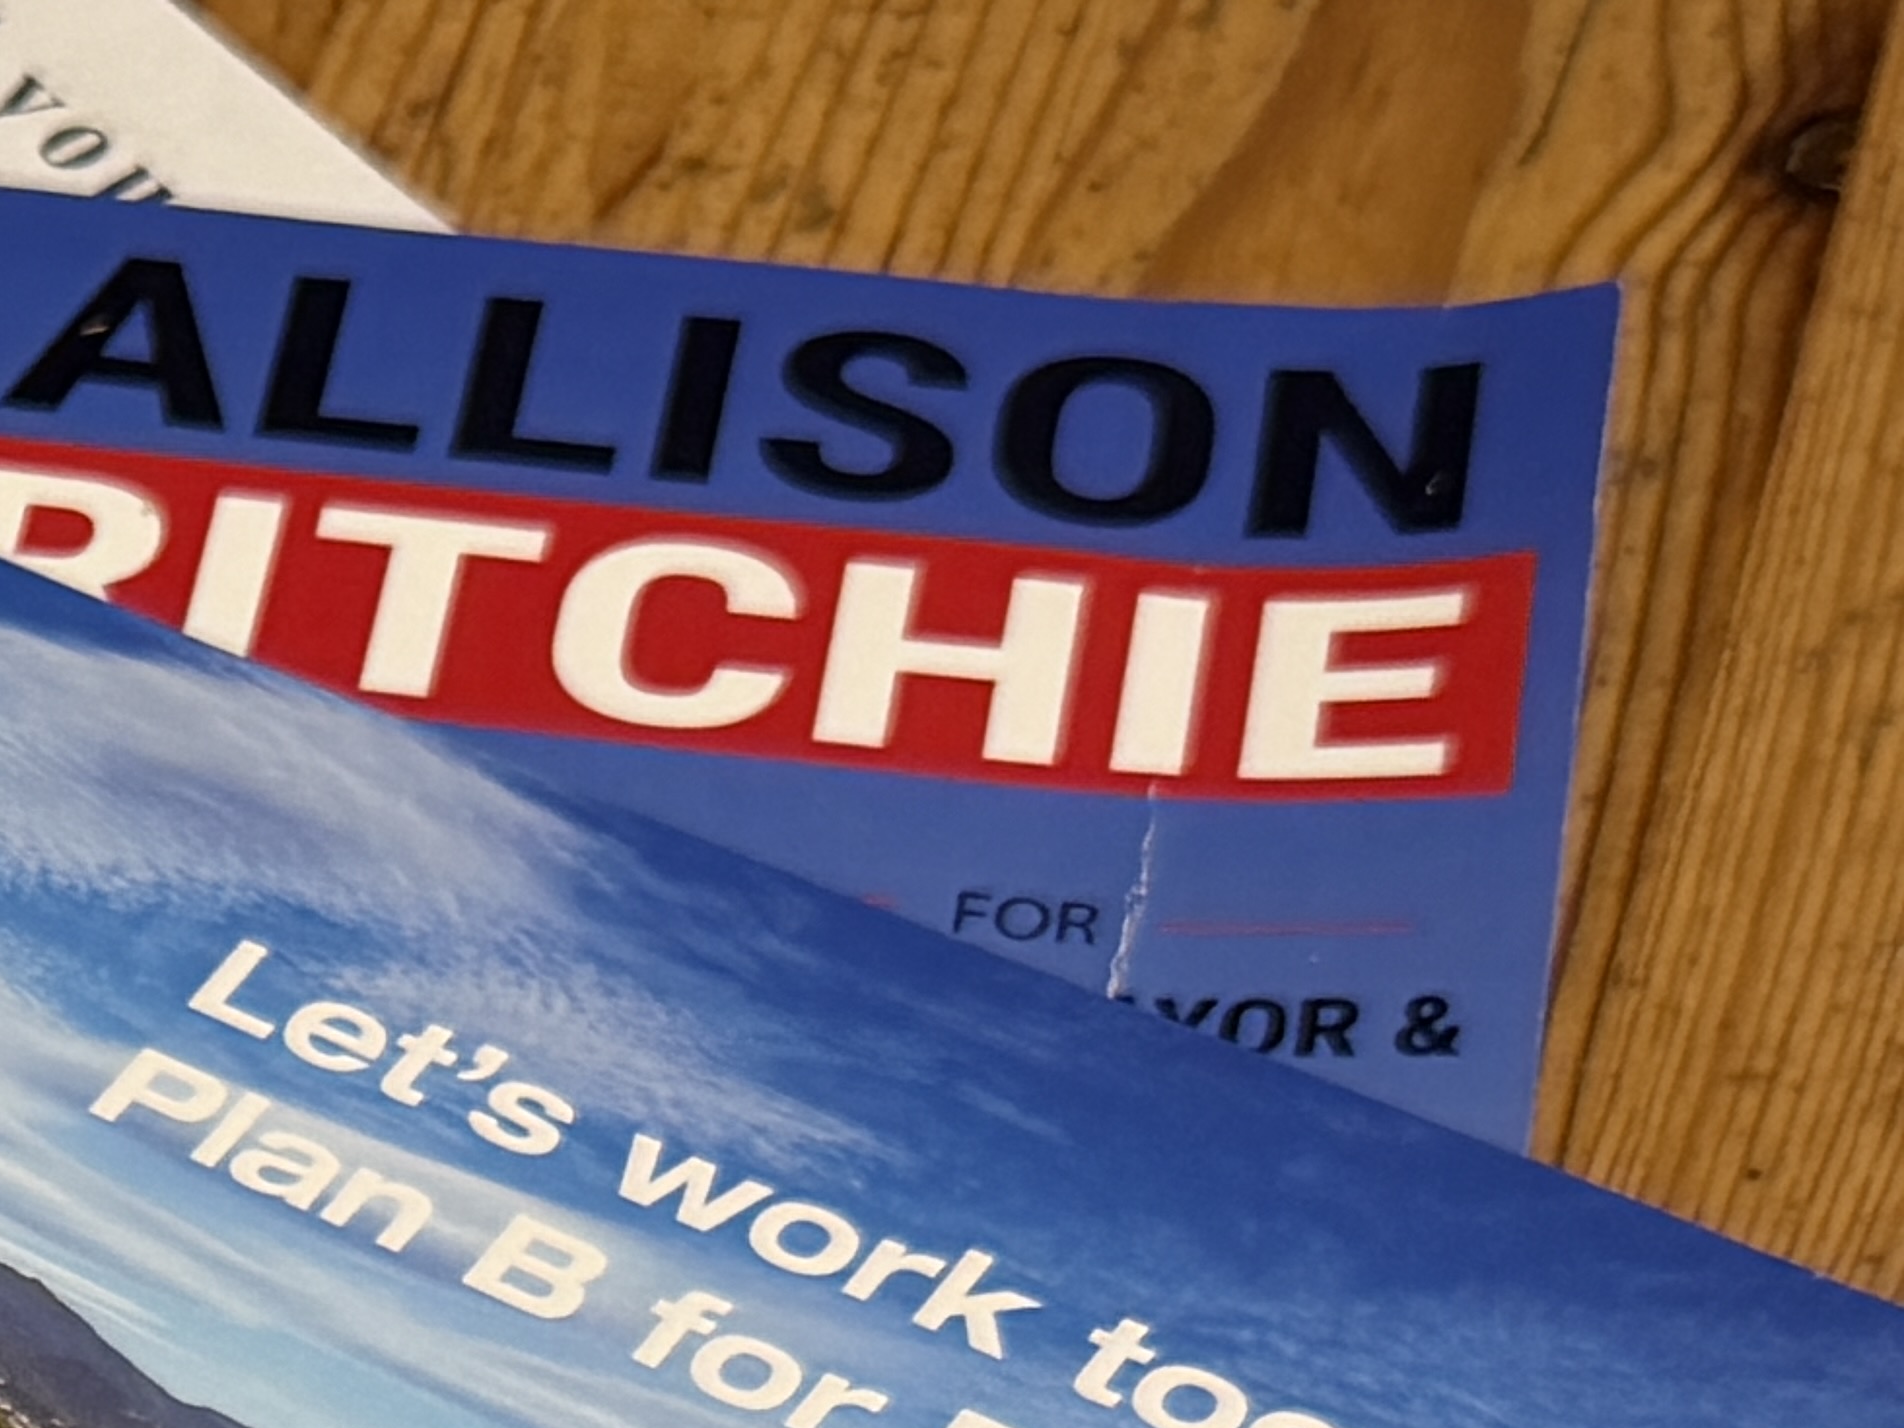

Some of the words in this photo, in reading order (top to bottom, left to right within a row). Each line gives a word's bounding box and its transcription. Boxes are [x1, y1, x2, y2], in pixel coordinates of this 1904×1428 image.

[952, 890, 1100, 945] FOR
[1393, 994, 1461, 1057] &
[88, 1047, 434, 1253] Plan
[461, 1215, 609, 1320] B
[188, 938, 576, 1157] Let’s
[617, 1132, 1041, 1361] work
